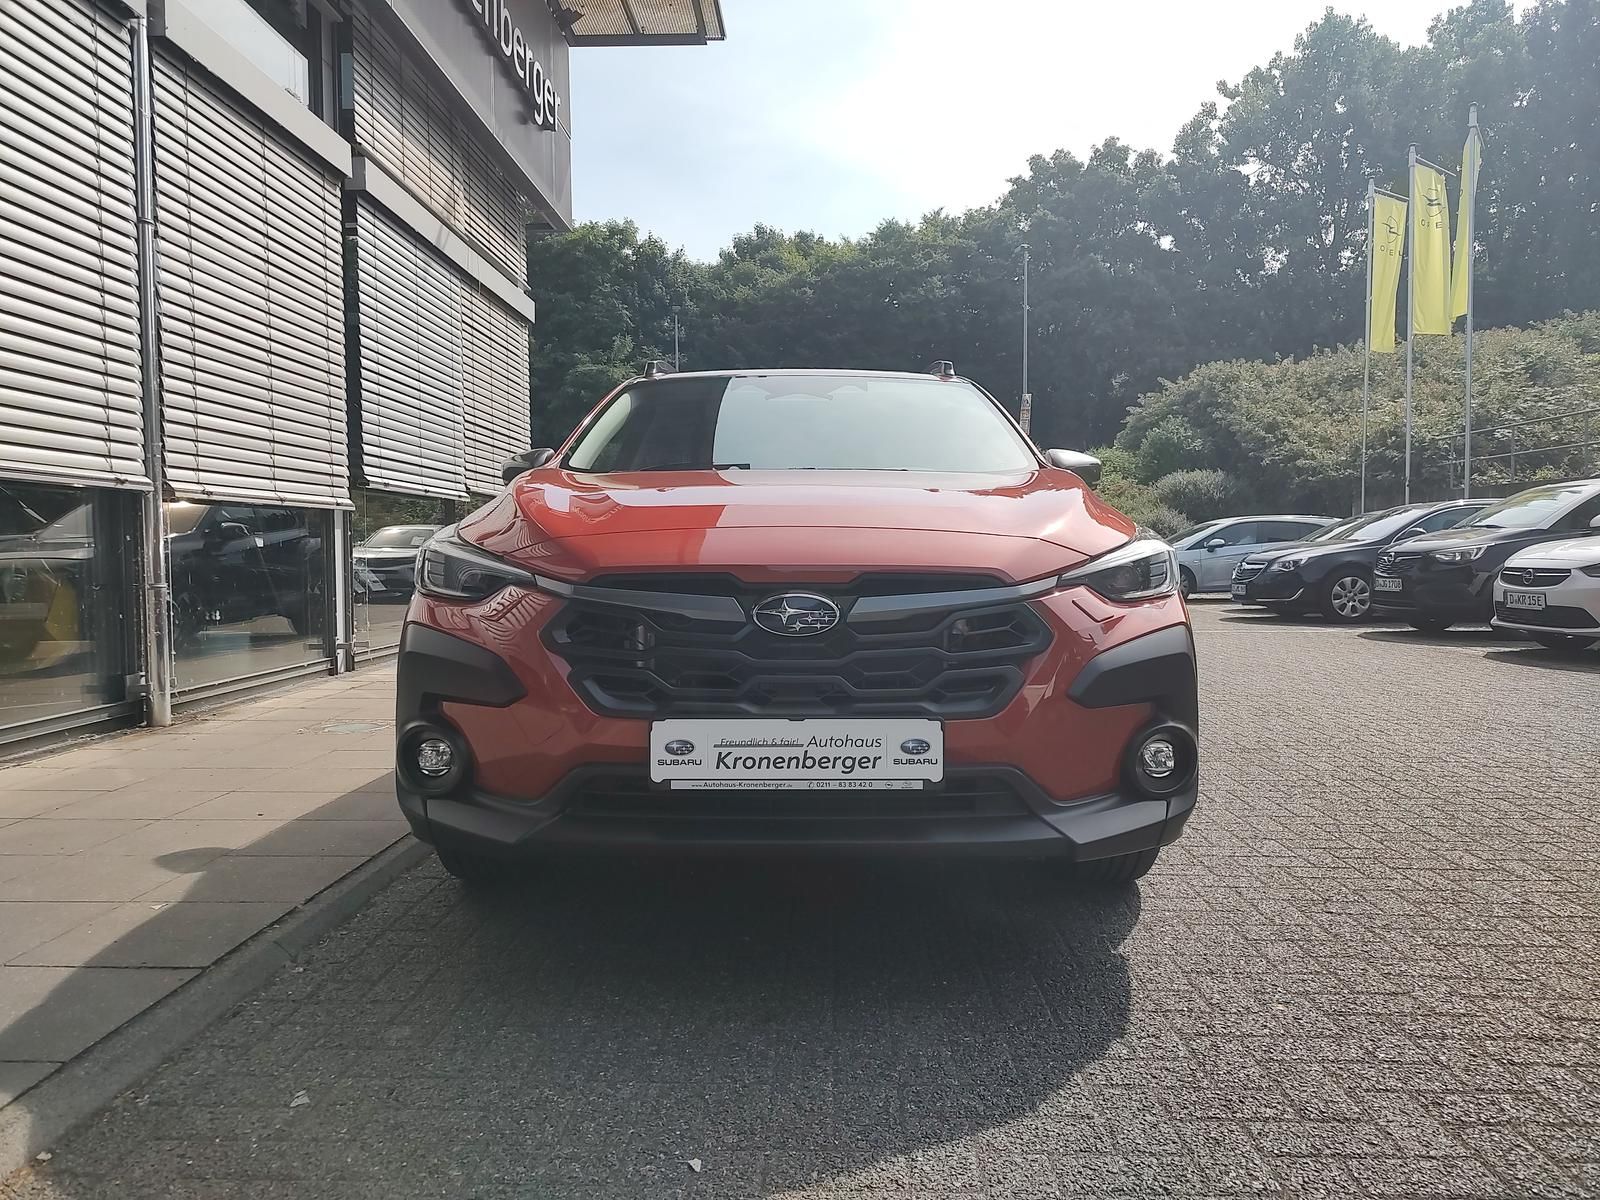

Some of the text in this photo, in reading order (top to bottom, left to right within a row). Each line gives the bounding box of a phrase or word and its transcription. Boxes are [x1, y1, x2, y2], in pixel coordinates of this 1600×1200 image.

[472, 0, 561, 132] nberger
[720, 737, 799, 746] Freundlich & fair!
[807, 734, 882, 748] Autohaus
[715, 750, 882, 774] Kronenberger
